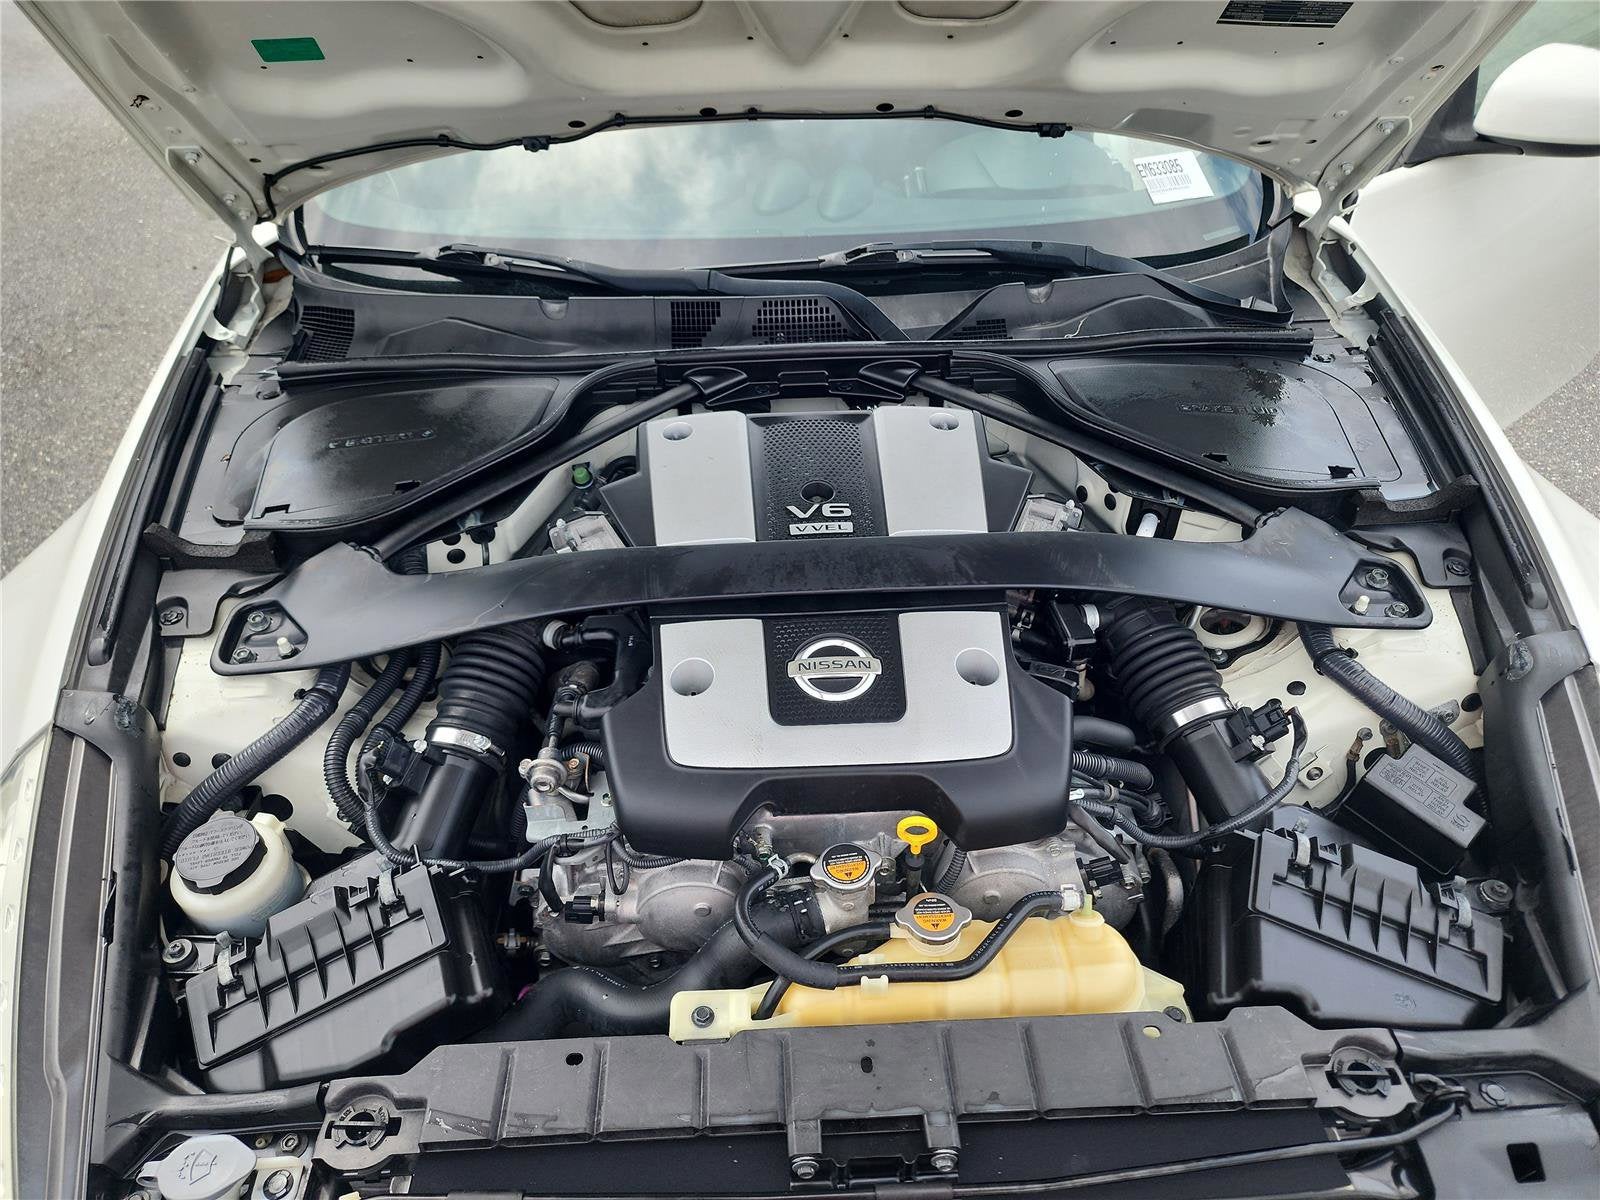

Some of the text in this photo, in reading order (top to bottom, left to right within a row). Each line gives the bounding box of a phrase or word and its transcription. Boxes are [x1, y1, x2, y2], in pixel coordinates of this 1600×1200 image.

[1135, 158, 1184, 178] EM633085
[786, 503, 852, 519] V6
[795, 523, 848, 533] VVEL
[797, 659, 872, 672] NISSAN
